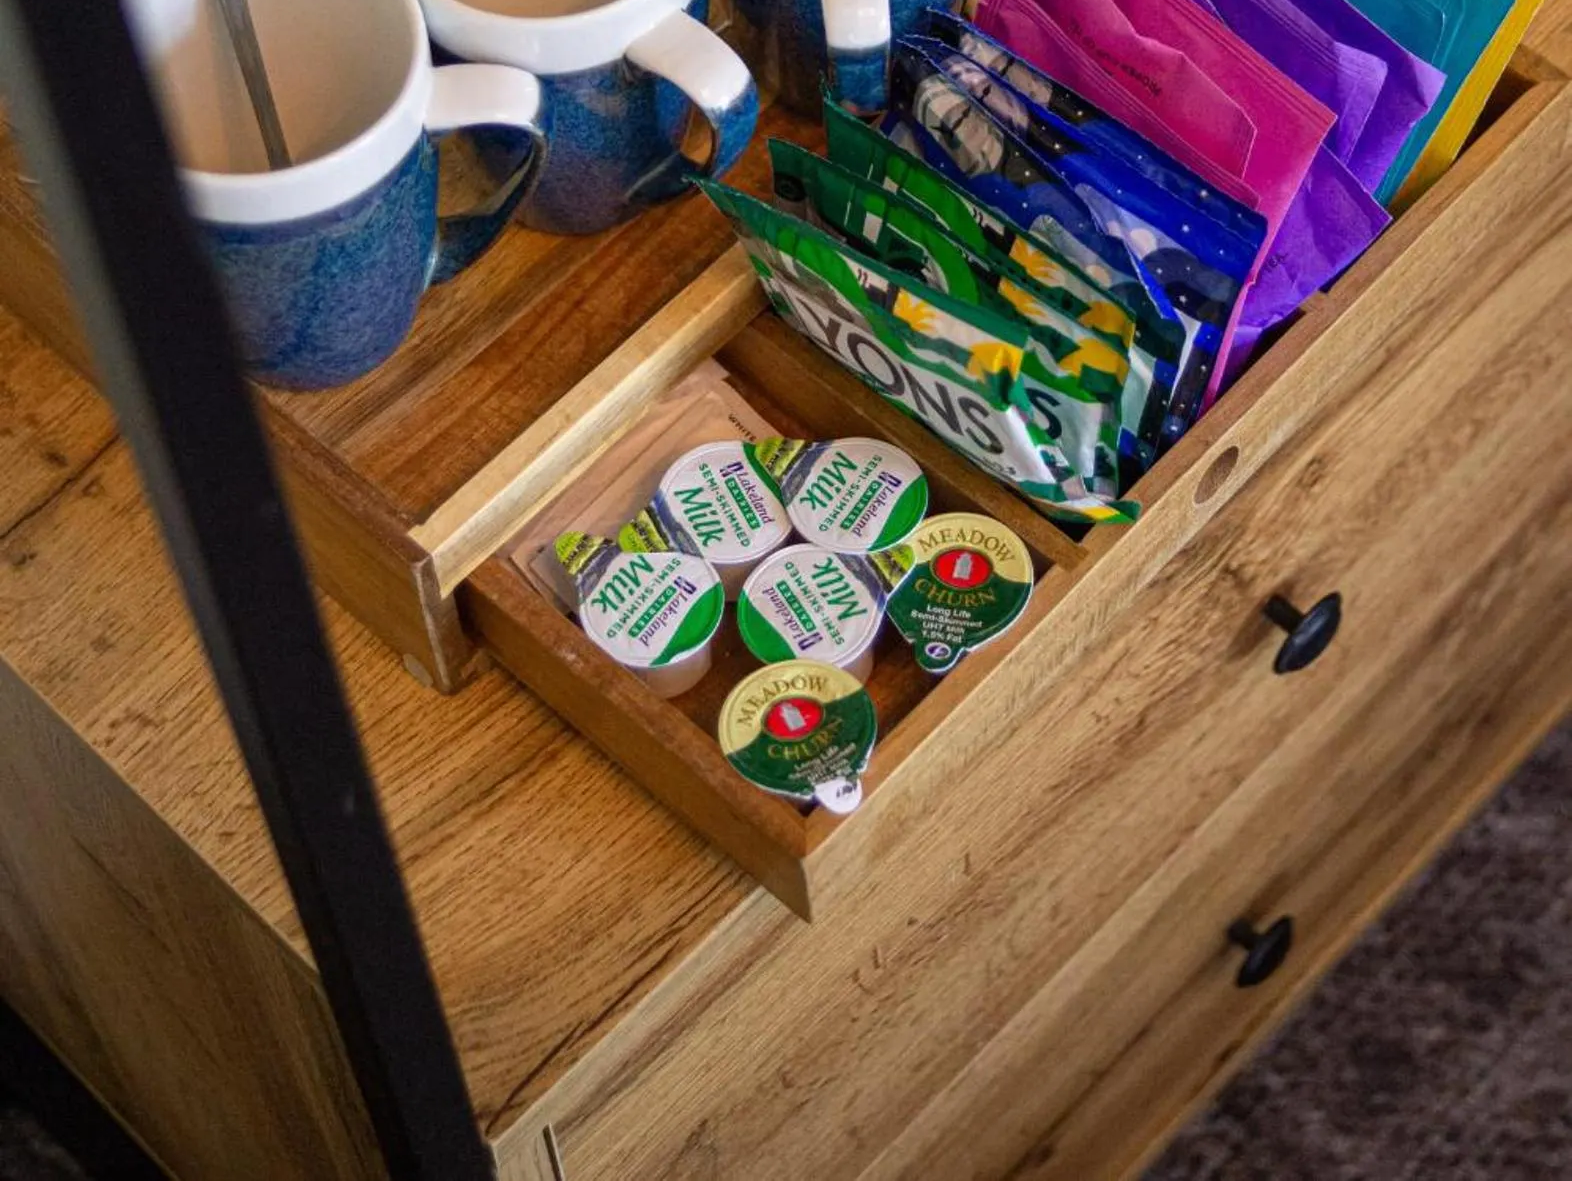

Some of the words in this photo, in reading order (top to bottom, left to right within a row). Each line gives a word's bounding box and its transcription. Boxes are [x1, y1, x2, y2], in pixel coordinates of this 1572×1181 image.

[727, 412, 757, 443] WHITE
[698, 462, 752, 548] SEMI-SKIMMED
[735, 470, 775, 524] Lakeland
[798, 449, 859, 515] Milk
[817, 453, 881, 532] SEMI-SKIMMED
[851, 484, 894, 536] Lakeland
[673, 483, 729, 548] Milk
[919, 528, 1018, 567] MEADOW
[590, 553, 655, 618] Milk
[604, 557, 681, 640] SEMI-SKIMMED
[762, 585, 804, 640] Lakeland
[783, 560, 845, 645] SEMI-SKIMMED
[806, 555, 869, 622] Milk
[915, 579, 996, 608] CHURN
[926, 604, 950, 616] Long
[953, 609, 971, 618] Life
[637, 590, 689, 646] Lakeland
[737, 676, 827, 728] MEADOW
